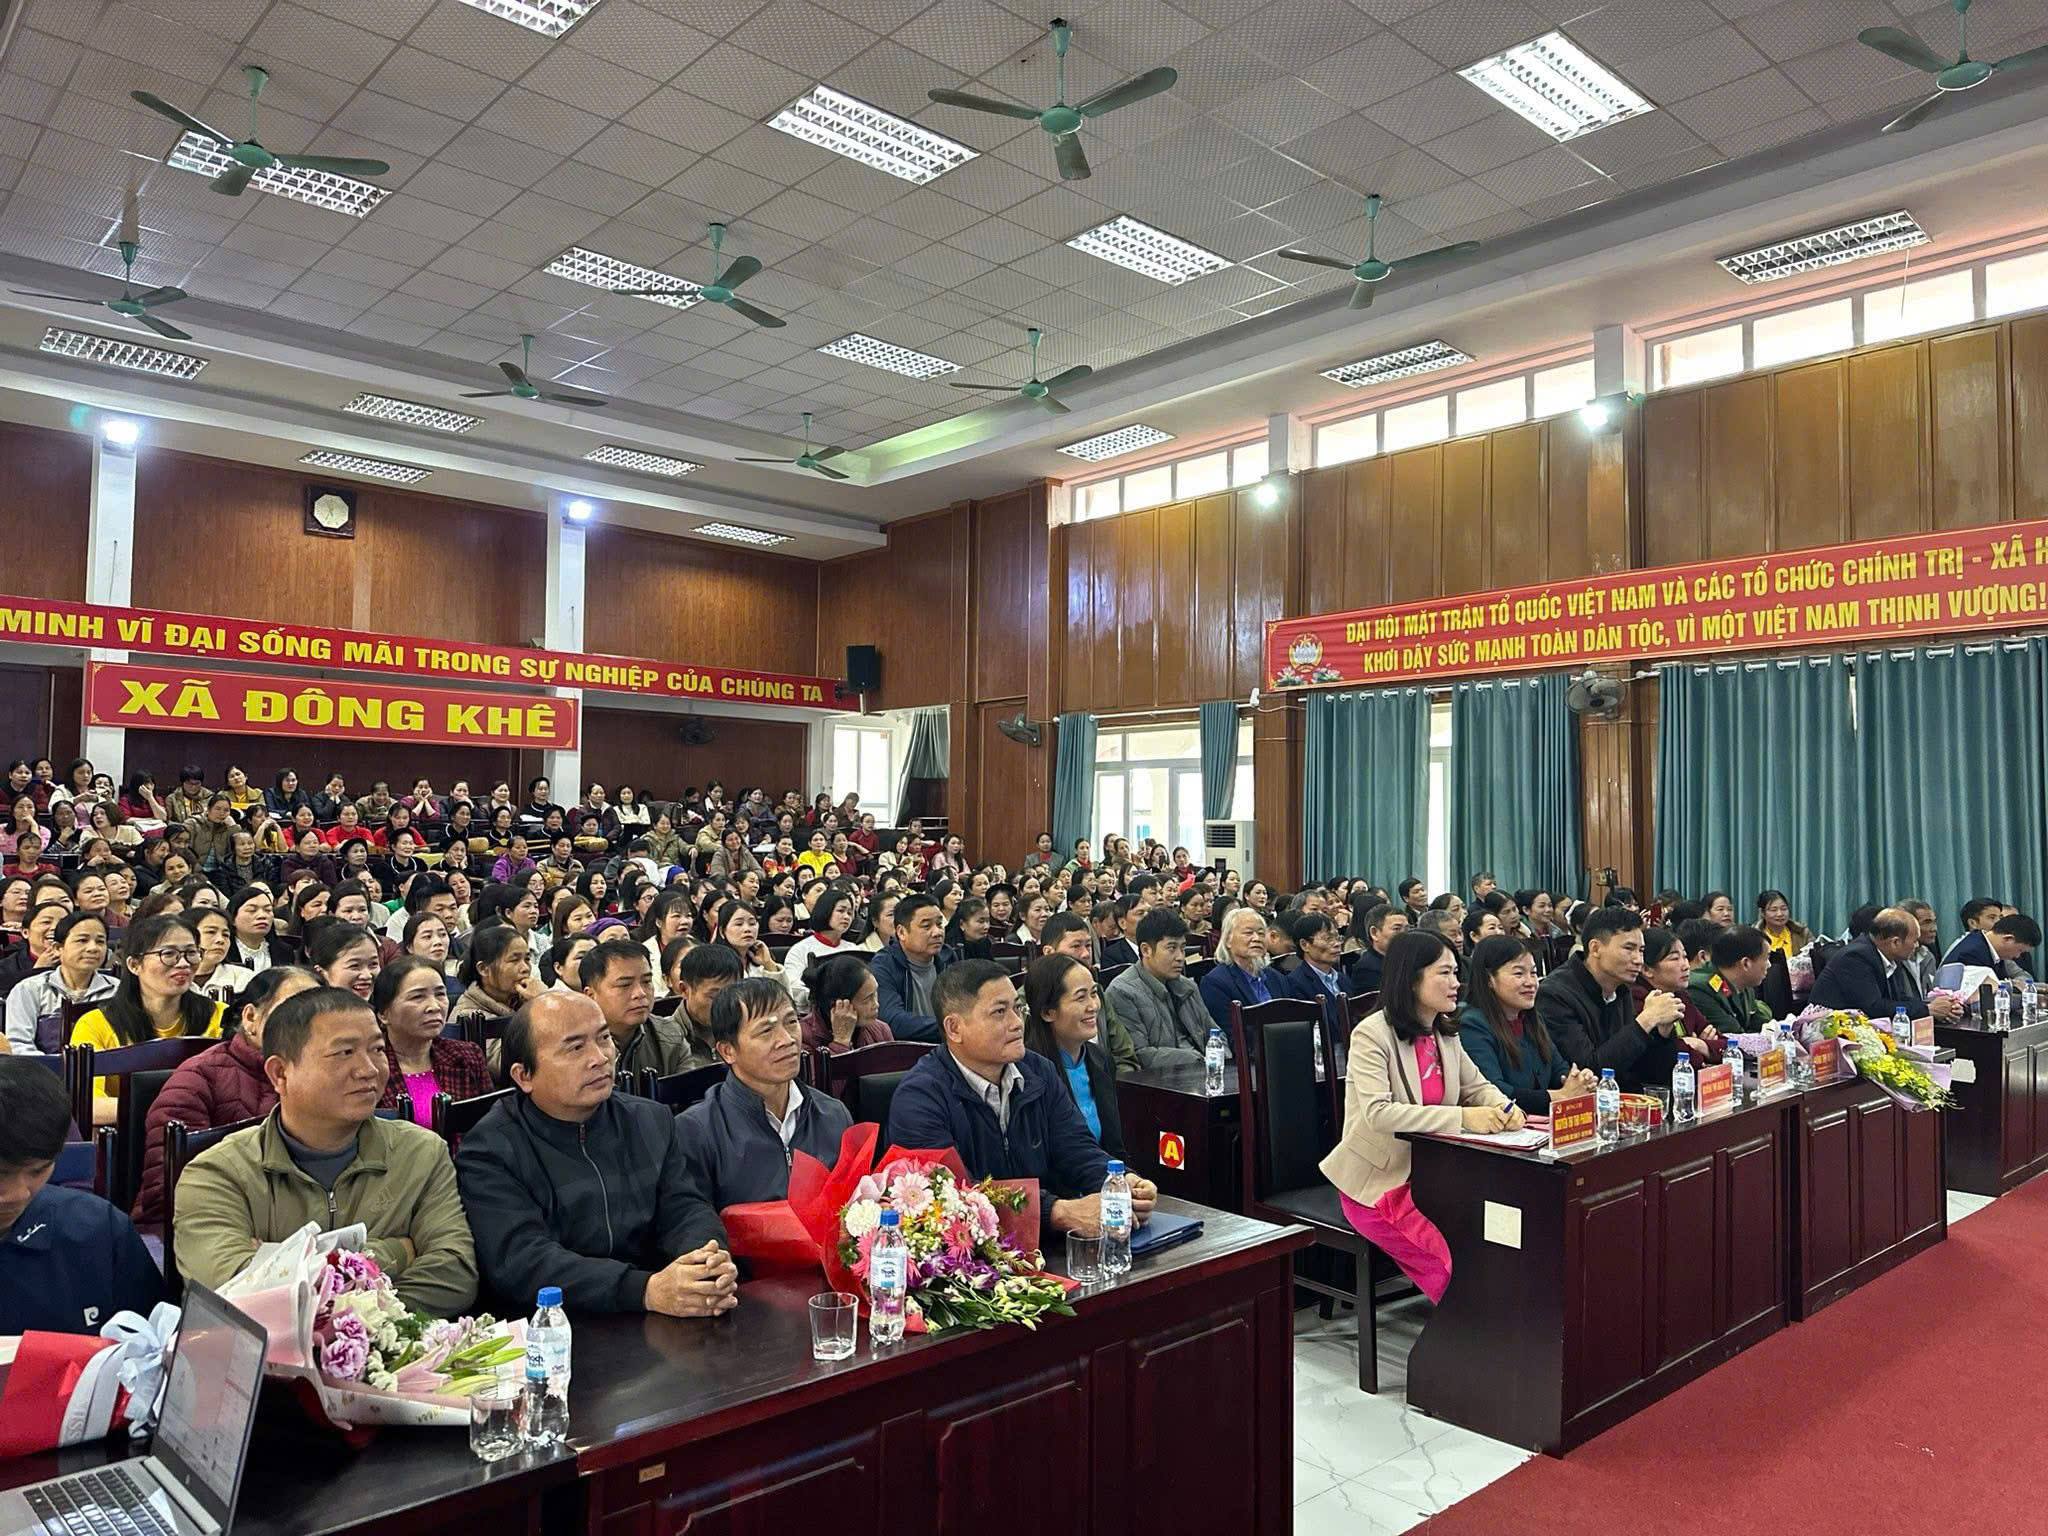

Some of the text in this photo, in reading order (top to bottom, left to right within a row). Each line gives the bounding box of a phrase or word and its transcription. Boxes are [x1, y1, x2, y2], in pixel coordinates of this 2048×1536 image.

[1346, 620, 1371, 646] ĐẠI
[1374, 613, 1400, 643] HỘI
[1404, 609, 1438, 639] MẶT
[1441, 603, 1485, 634] TRẬN
[1489, 593, 1510, 626] TỔ
[1514, 589, 1562, 625] QUỐC
[1567, 586, 1606, 620] VIỆT
[1611, 583, 1657, 612] NAM
[1661, 575, 1689, 607] VÀ
[1694, 570, 1736, 603] CÁC
[1741, 560, 1769, 598] TỔ
[1774, 559, 1835, 594] CHỨC
[1842, 550, 1917, 587] CHÍNH
[1923, 545, 1964, 580] TRỊ
[1990, 533, 2027, 570] XÃ
[1403, 643, 1433, 673] DẬY
[1437, 638, 1470, 666] SỨC
[1475, 635, 1526, 666] MẠNH
[1530, 627, 1578, 657] TOÀN
[1583, 622, 1622, 653] DÂN
[1628, 617, 1671, 652] TỘC,
[1676, 612, 1696, 644] VÌ
[1702, 608, 1747, 645] MỘT
[1752, 602, 1799, 640] VIỆT
[1806, 600, 1860, 632] NAM
[1866, 592, 1940, 630] THỊNH
[1947, 581, 2047, 622] VƯỢNG!
[0, 607, 822, 702] MINH VĨ ĐẠI SỐNG MÃI TRONG SỰ NGHIỆP CỦA CHÚNG TA
[119, 678, 556, 738] XÃ ĐÔNG KHÊ
[1164, 1140, 1180, 1161] A
